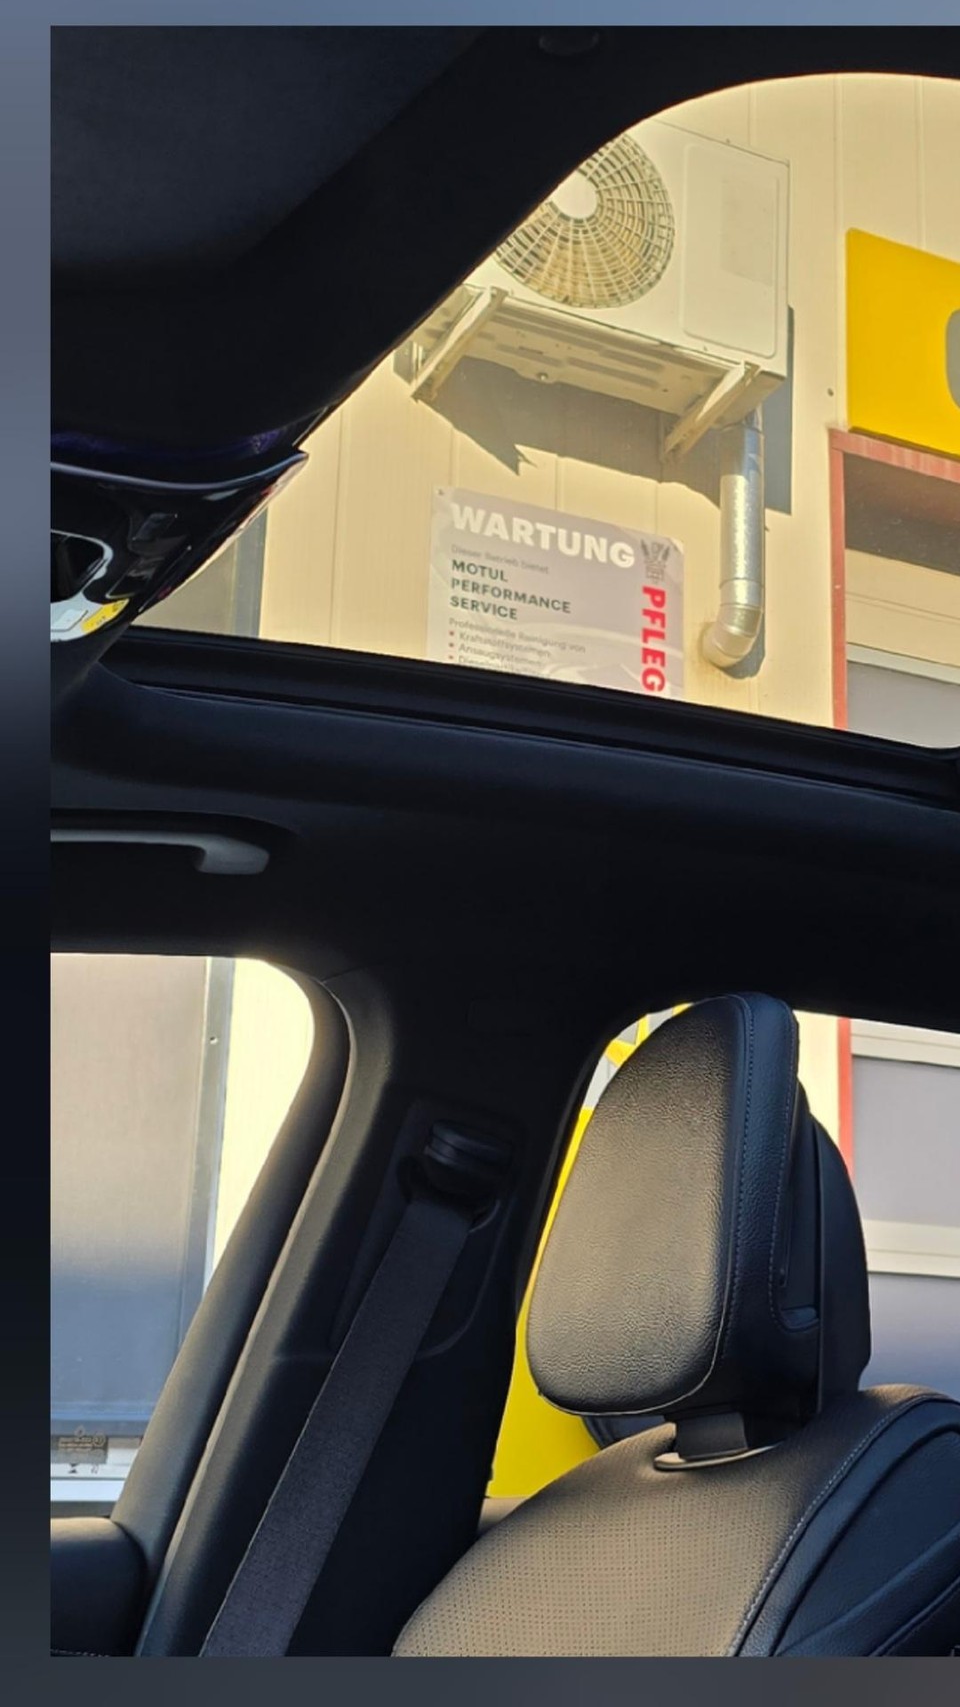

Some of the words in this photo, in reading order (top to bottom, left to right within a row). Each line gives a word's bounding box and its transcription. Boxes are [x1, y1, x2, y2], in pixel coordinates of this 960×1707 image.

[450, 502, 635, 568] WARTUNG
[452, 559, 508, 582] MOTUL
[450, 596, 518, 620] SERVICE
[451, 578, 571, 614] PERFORMANCE
[641, 585, 666, 692] PFLEG
